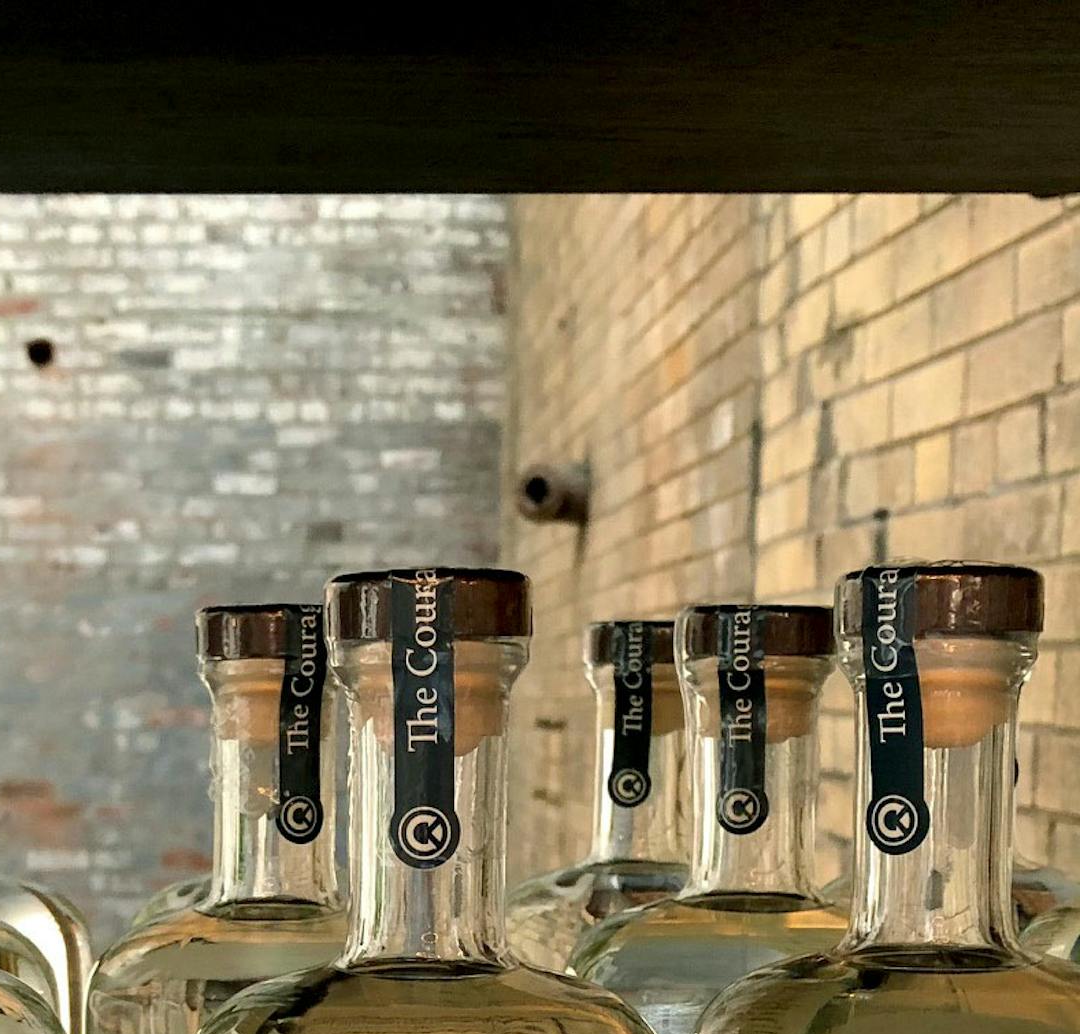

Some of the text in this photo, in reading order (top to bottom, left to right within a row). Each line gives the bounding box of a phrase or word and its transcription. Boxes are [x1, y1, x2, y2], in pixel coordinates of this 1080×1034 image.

[286, 703, 309, 755] The
[405, 686, 438, 753] The
[622, 694, 644, 737] The
[728, 698, 753, 748] The
[880, 681, 906, 743] The
